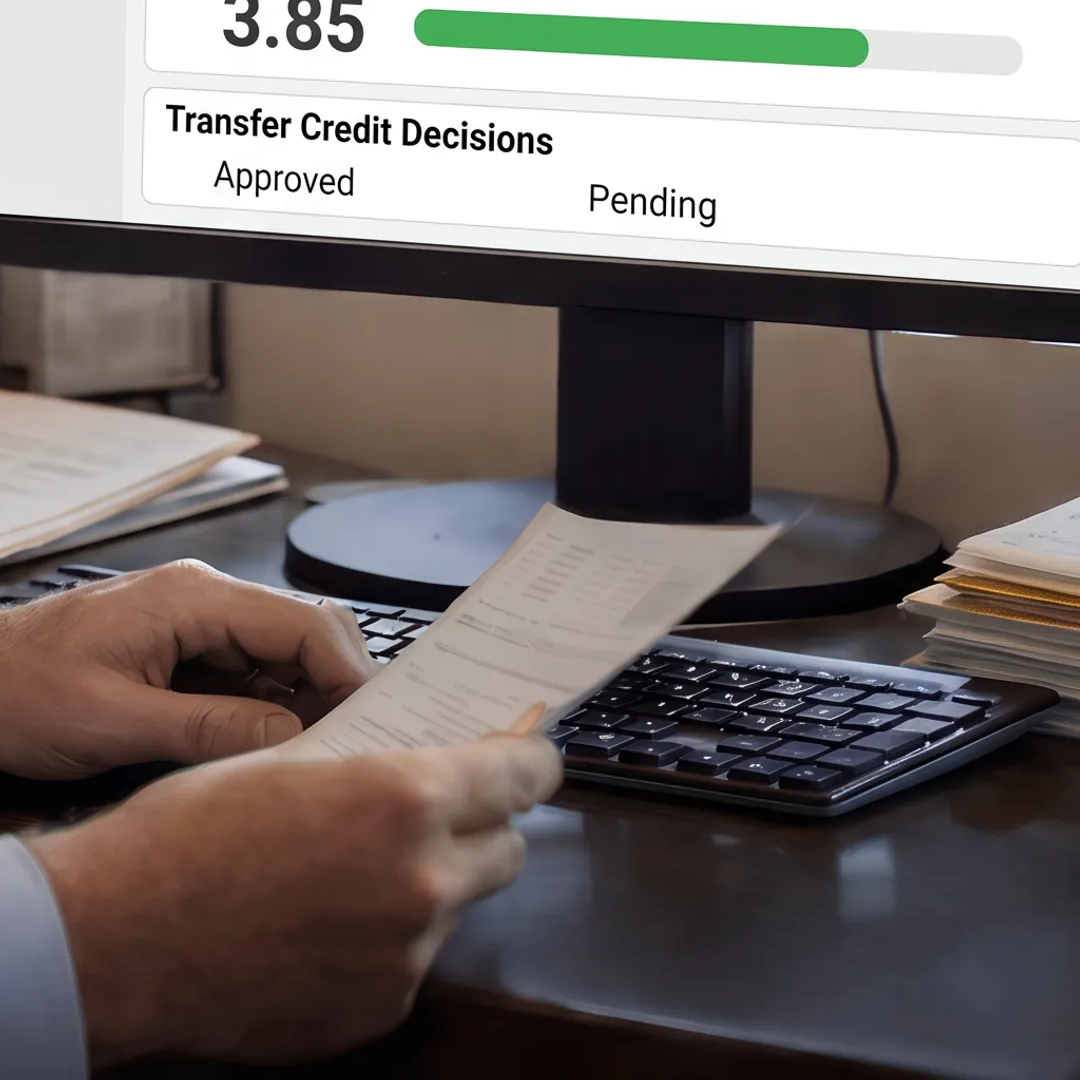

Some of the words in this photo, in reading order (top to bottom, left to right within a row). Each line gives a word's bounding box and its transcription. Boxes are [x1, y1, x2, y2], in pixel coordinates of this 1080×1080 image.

[166, 104, 292, 138] Transfer
[301, 112, 392, 145] Credit
[402, 118, 553, 155] Decisions
[213, 160, 354, 198] Approved
[590, 184, 716, 228] Pending
